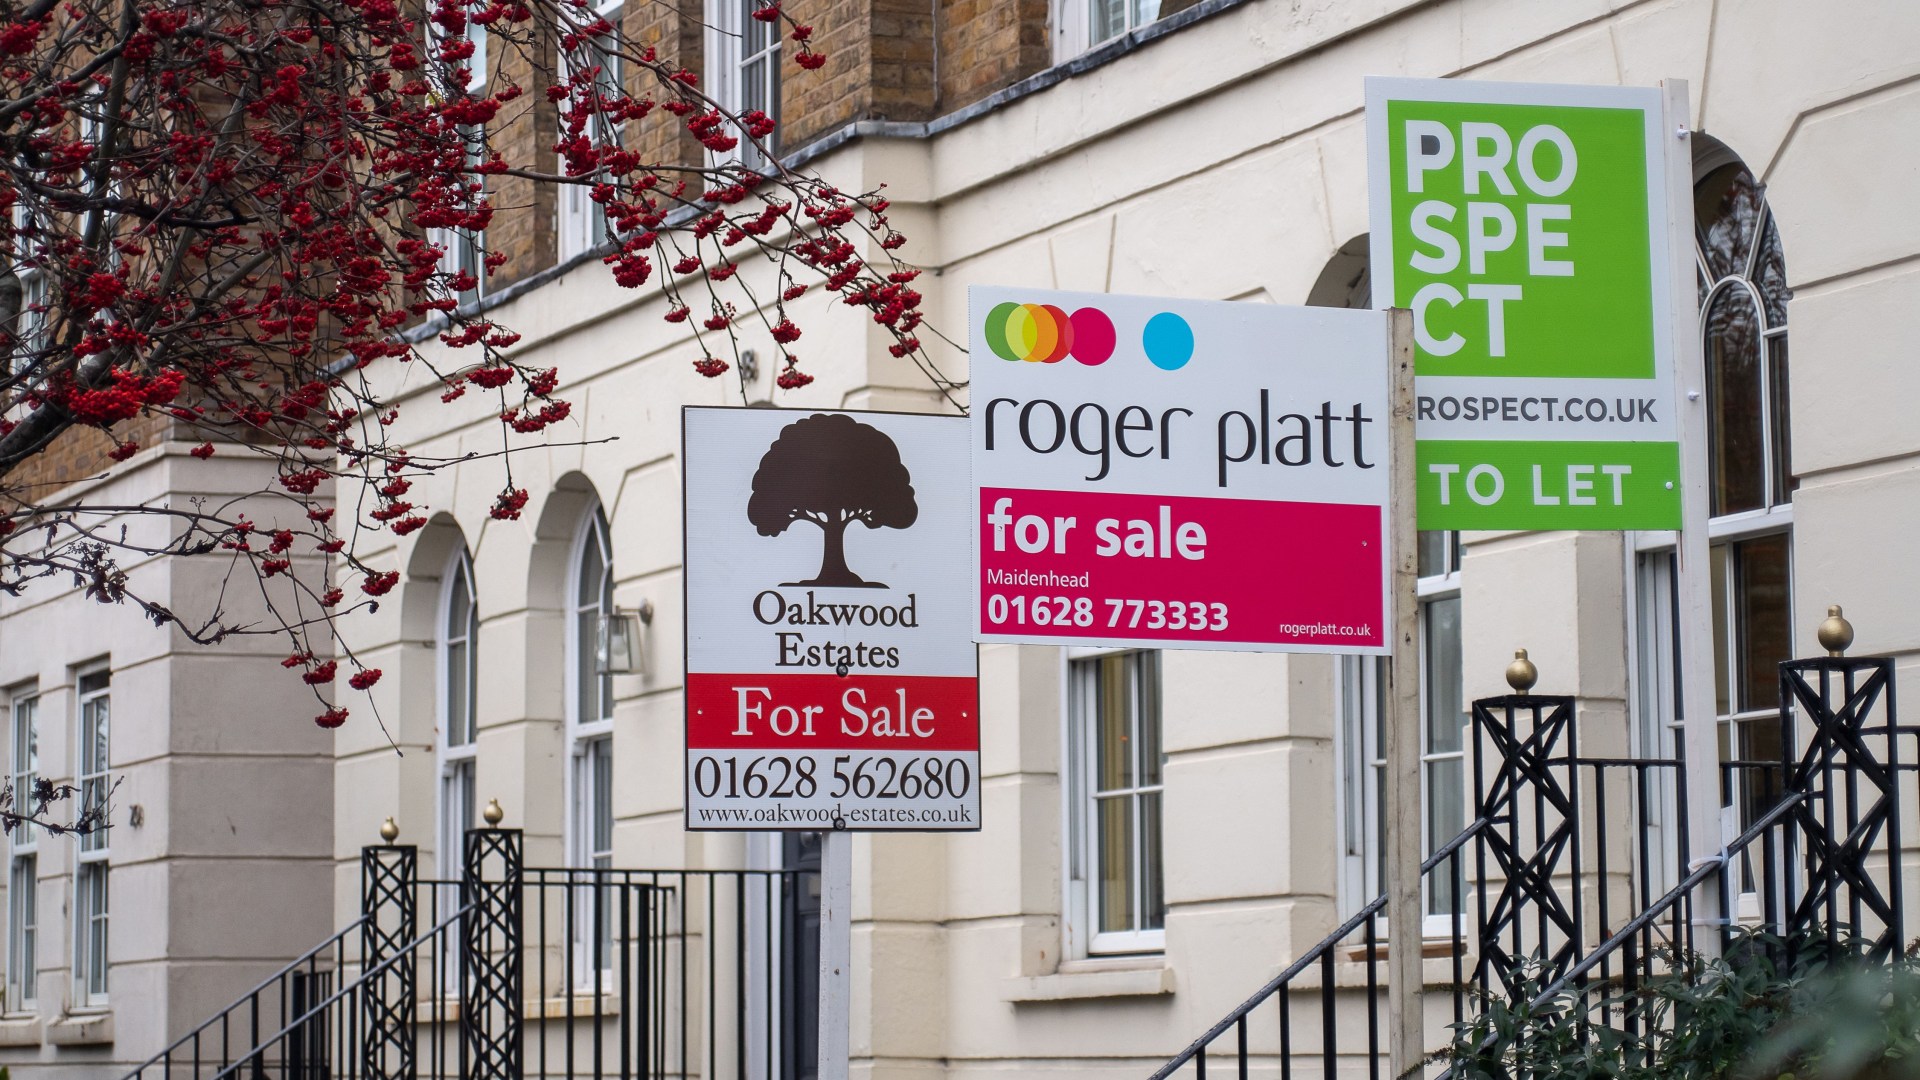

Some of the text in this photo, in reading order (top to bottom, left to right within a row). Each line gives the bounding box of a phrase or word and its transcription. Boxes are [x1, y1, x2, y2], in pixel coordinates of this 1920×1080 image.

[1405, 120, 1577, 197] PRO
[1409, 200, 1575, 277] SPE
[1410, 282, 1523, 357] CT
[1418, 396, 1658, 423] ROSPECT.CO.UK
[985, 388, 1375, 487] roger platt
[1428, 463, 1632, 506] TO LET
[987, 498, 1207, 560] for sale
[987, 568, 1090, 588] Maidenhead
[753, 590, 919, 627] Oakwood
[988, 594, 1229, 632] 01628 773333
[1280, 622, 1371, 637] rogerplatt.co.uk
[775, 632, 900, 669] Estates
[731, 686, 936, 738] For Sale
[694, 754, 971, 799] 01628 562680
[699, 803, 973, 823] www.oakwood-estates.co.uk
